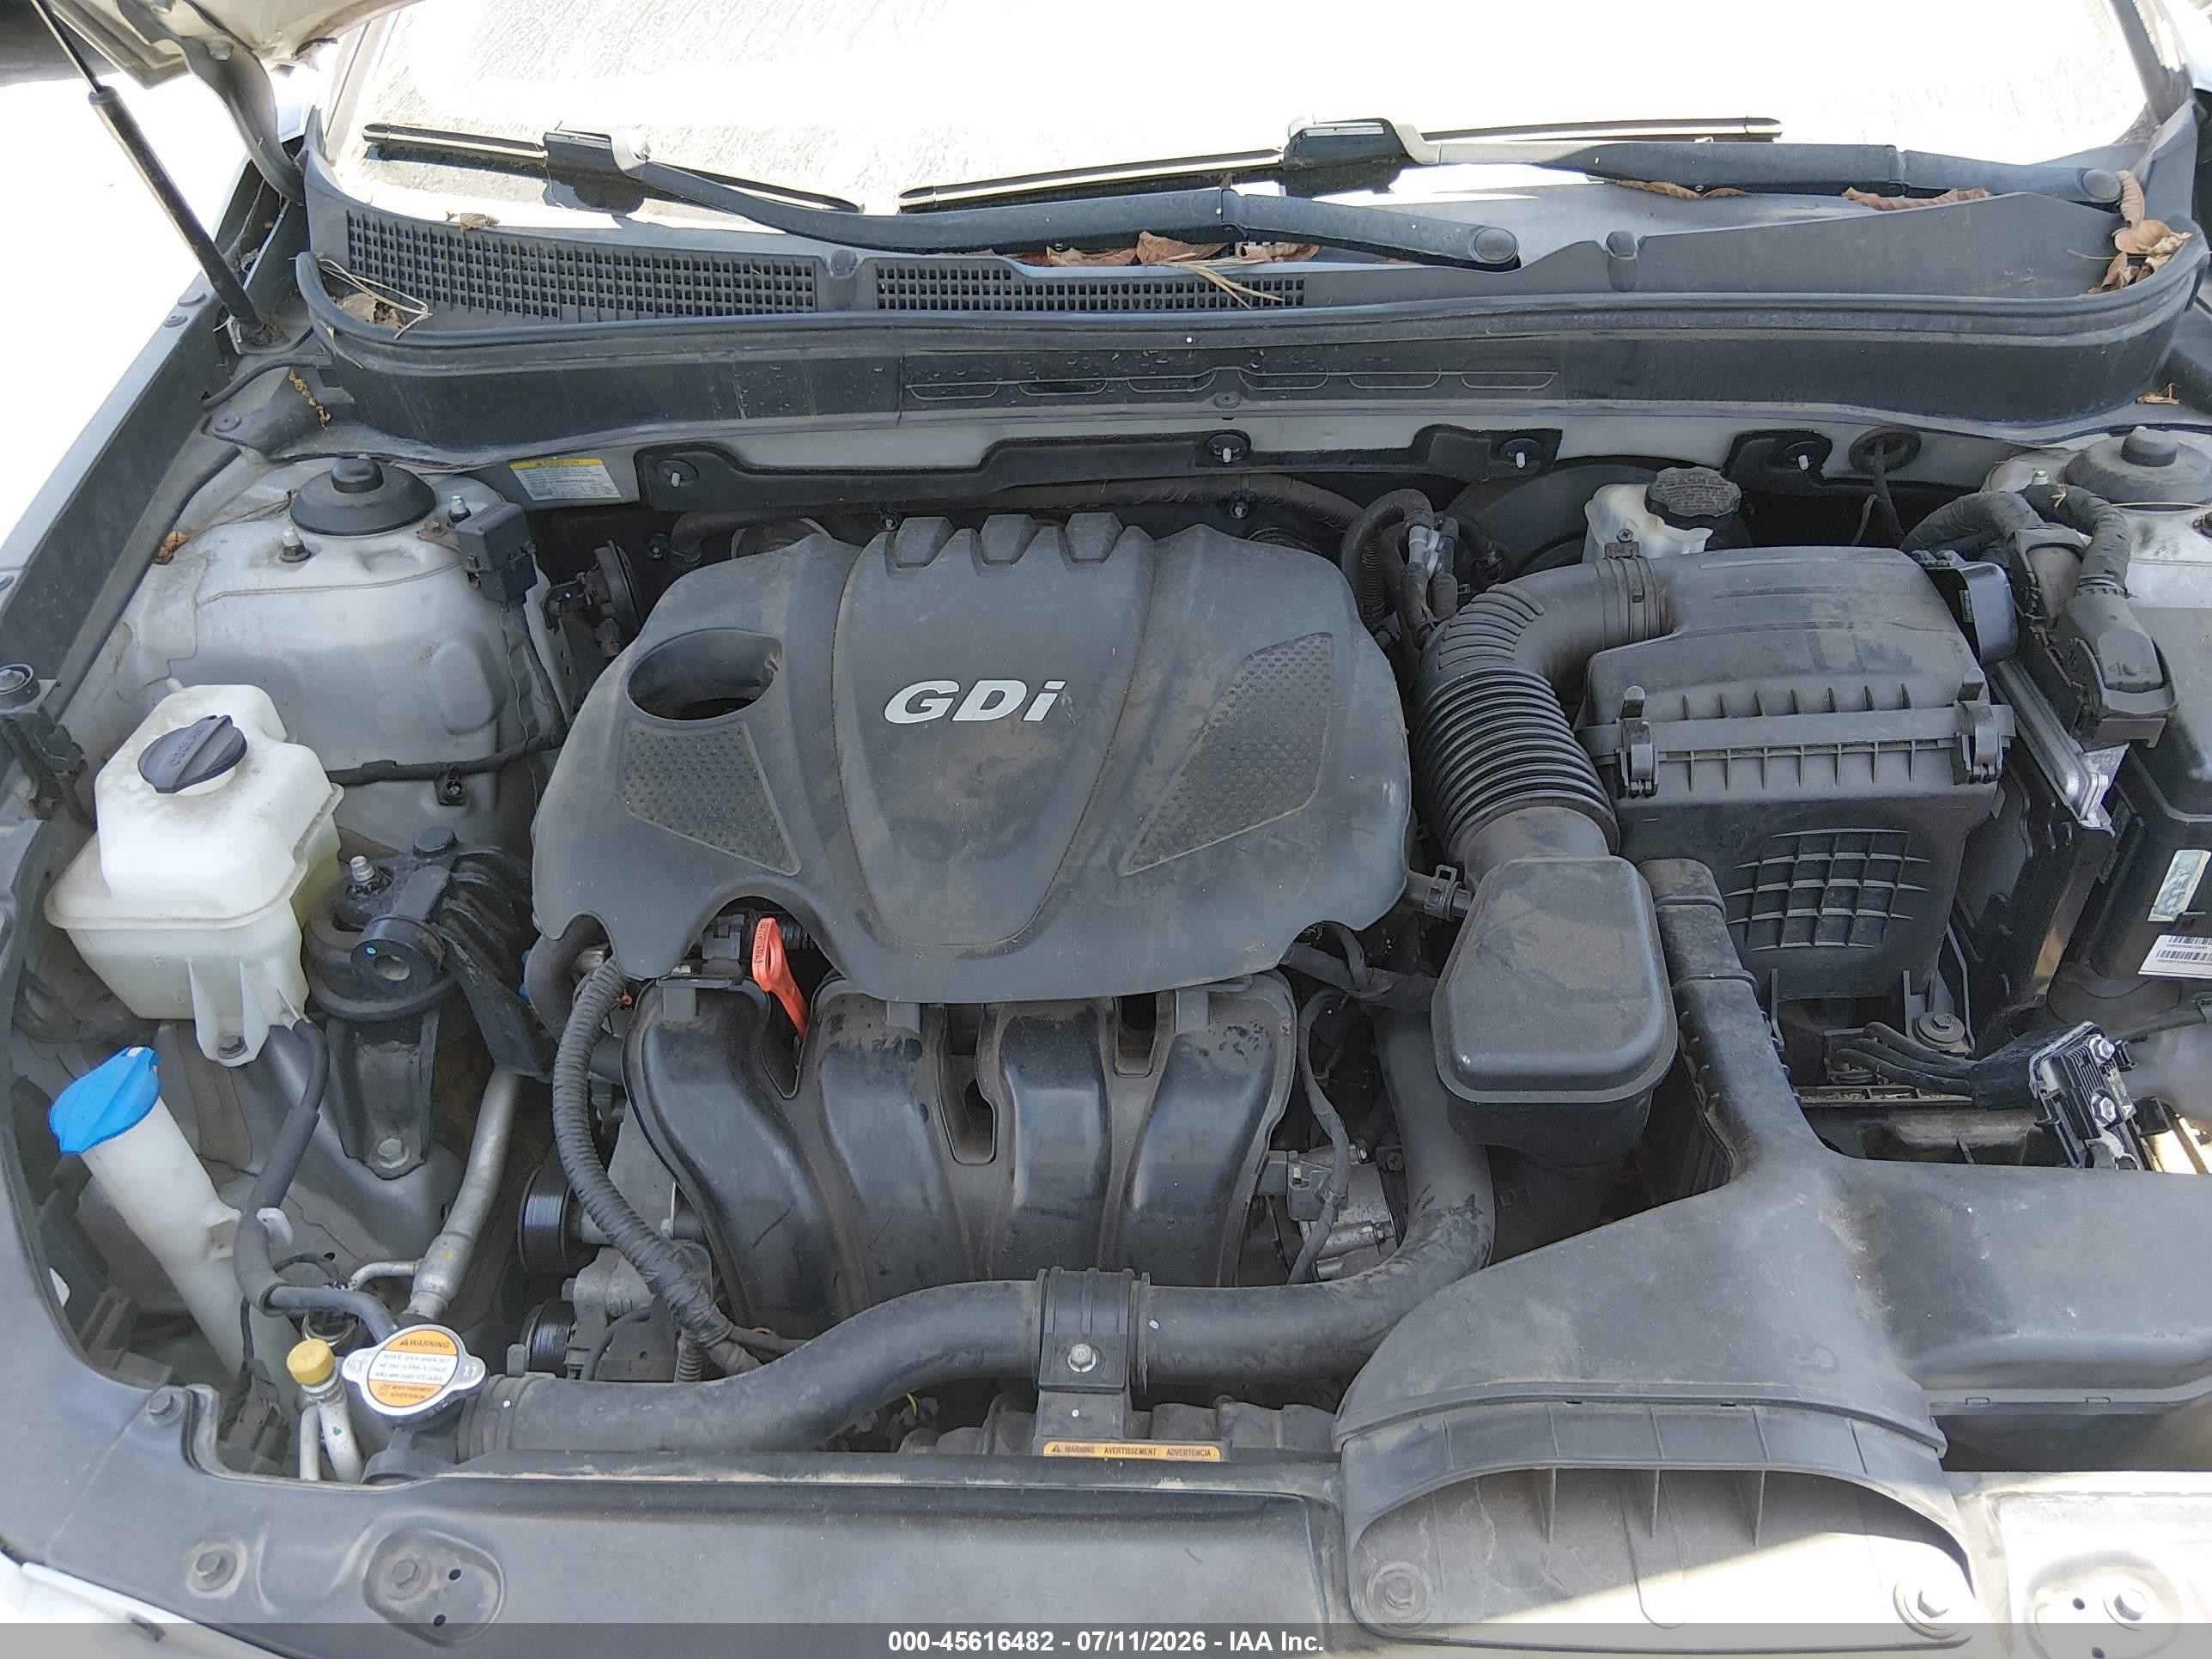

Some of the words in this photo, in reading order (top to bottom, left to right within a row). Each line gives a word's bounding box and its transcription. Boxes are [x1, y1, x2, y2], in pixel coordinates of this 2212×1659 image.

[884, 679, 1066, 724] GDi
[410, 1339, 450, 1349] WARNING
[1104, 1447, 1157, 1455] AVERTISSEMENT
[1166, 1449, 1211, 1457] ADVERTENCIA
